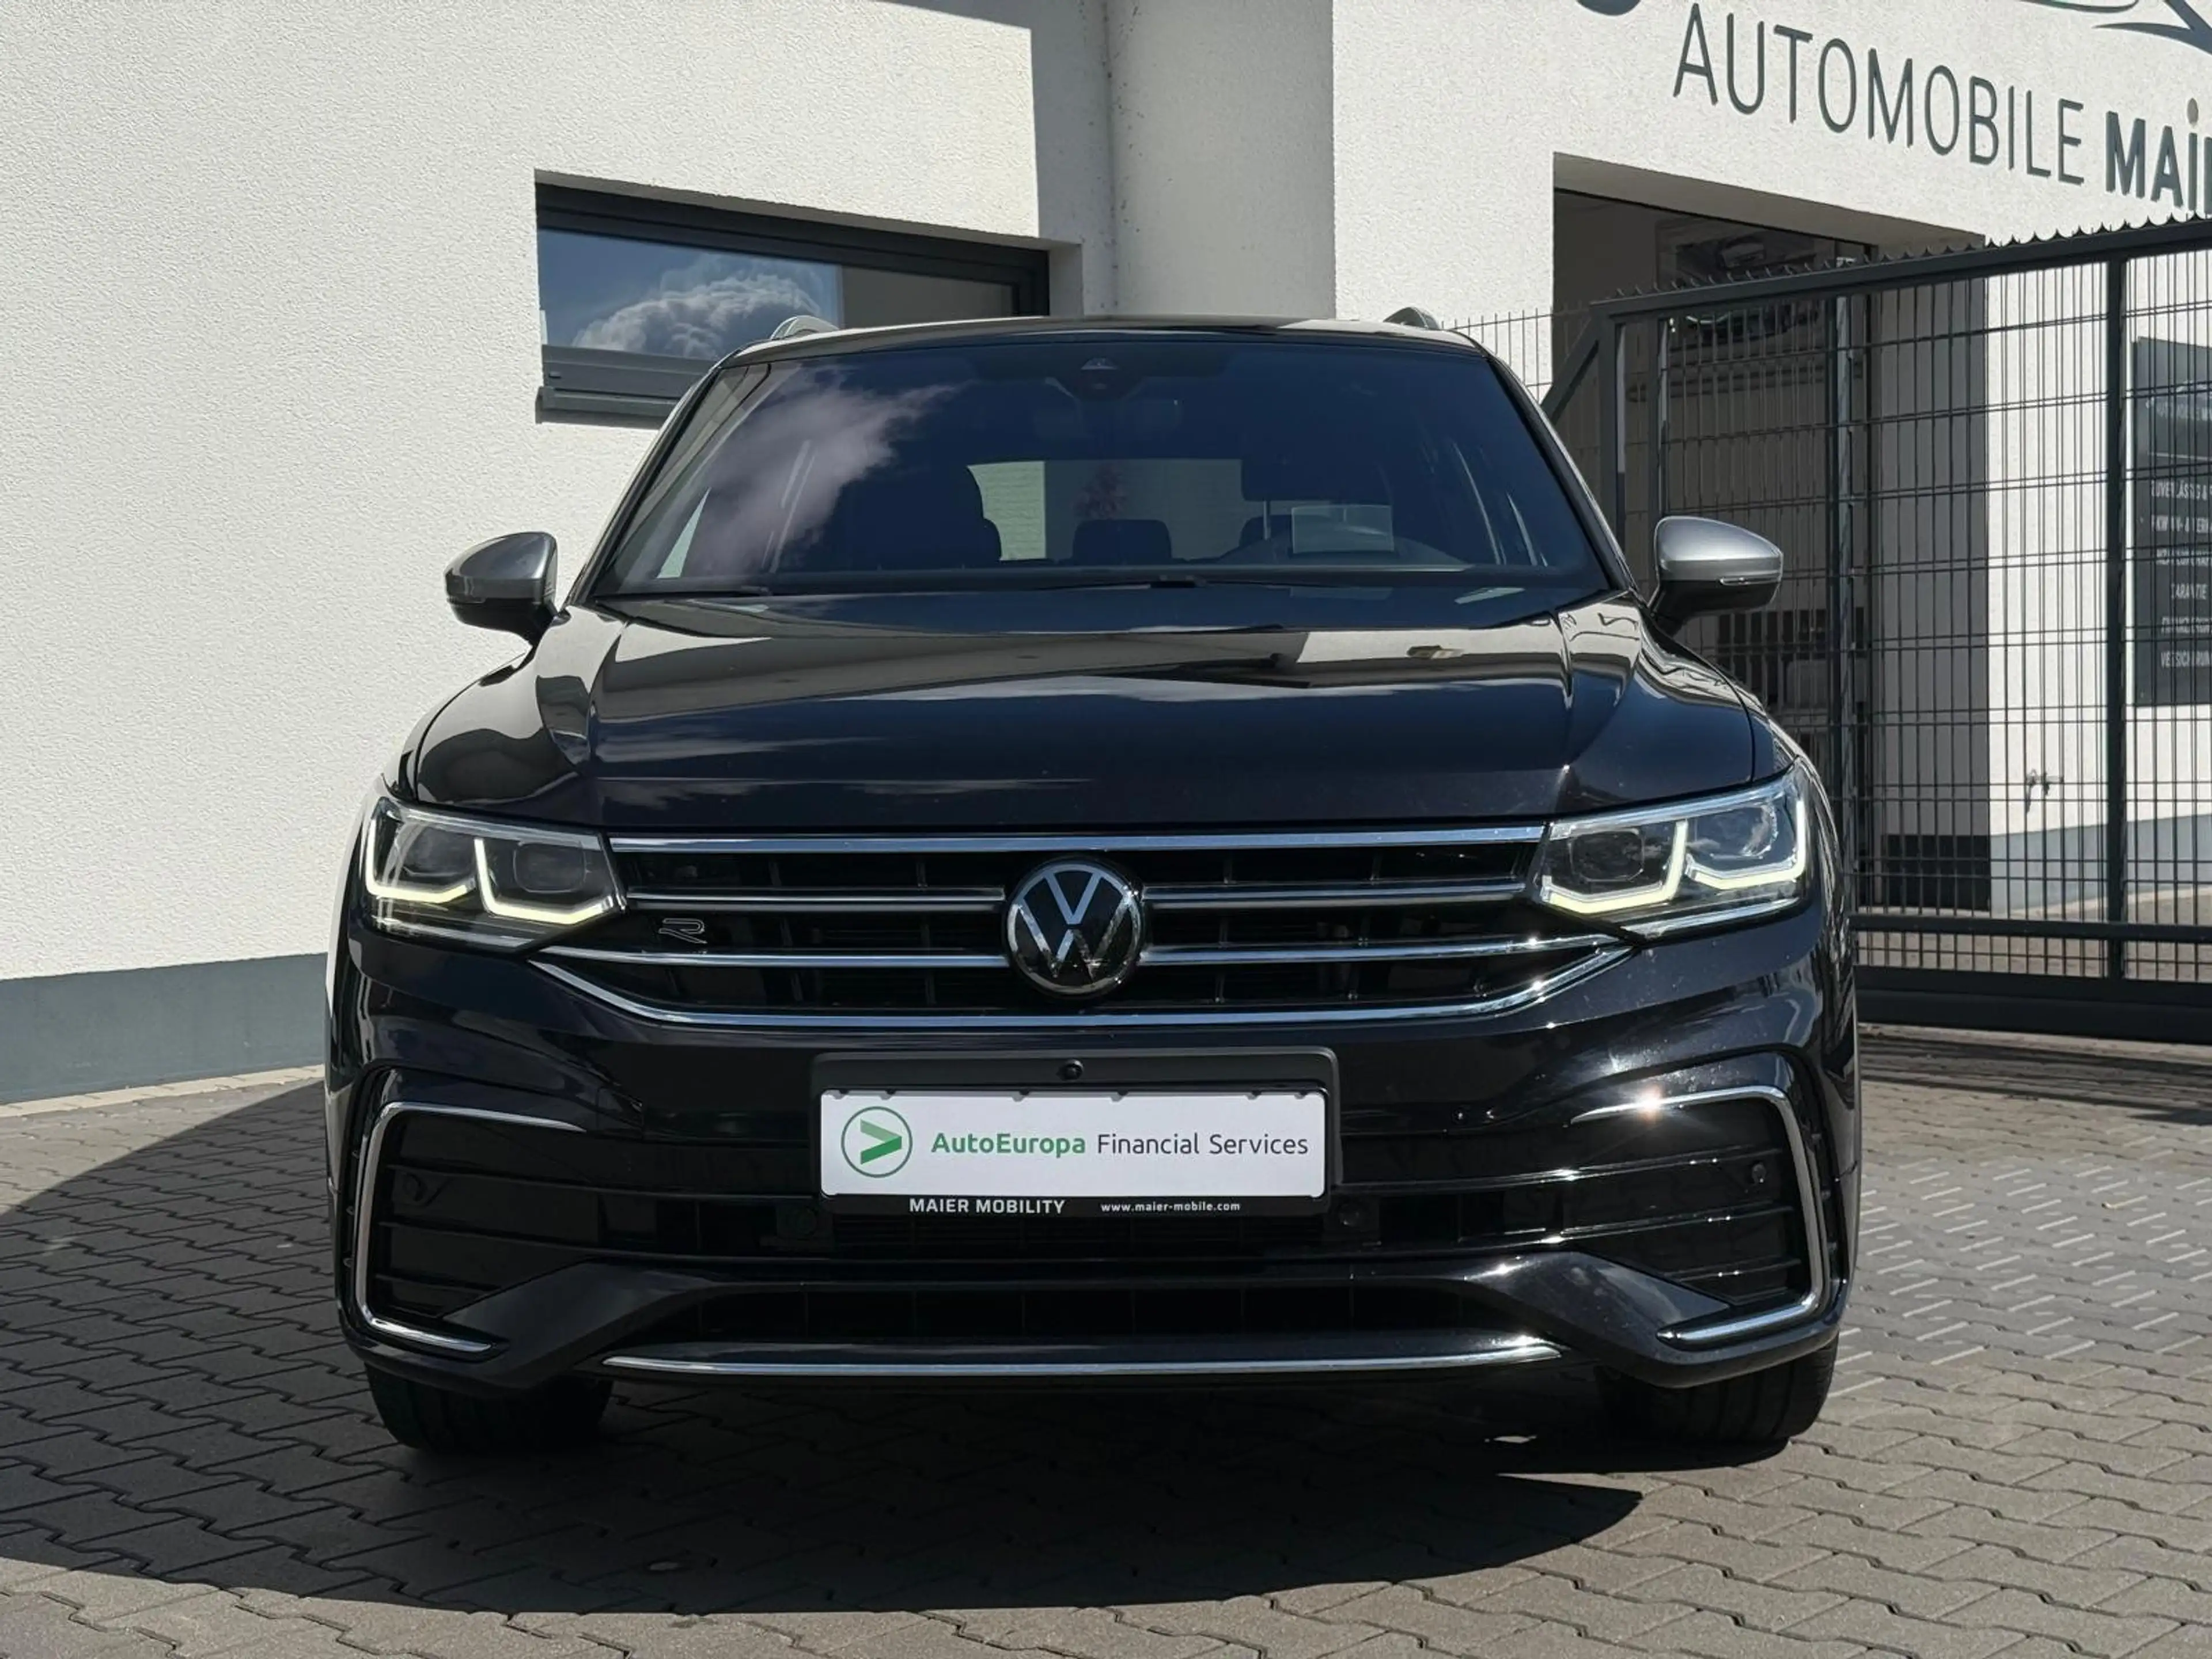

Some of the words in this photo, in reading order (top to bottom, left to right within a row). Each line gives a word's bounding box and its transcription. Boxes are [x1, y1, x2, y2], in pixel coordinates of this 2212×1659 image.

[1673, 2, 2085, 185] AUTOMOBILE
[931, 1132, 1086, 1158] AutoEuropa
[1097, 1132, 1200, 1154] Financial
[1209, 1133, 1309, 1154] Services
[909, 1198, 969, 1213] MAIER
[975, 1199, 1066, 1214] MOBILITY
[1100, 1201, 1241, 1213] www.maier-mobile.com
